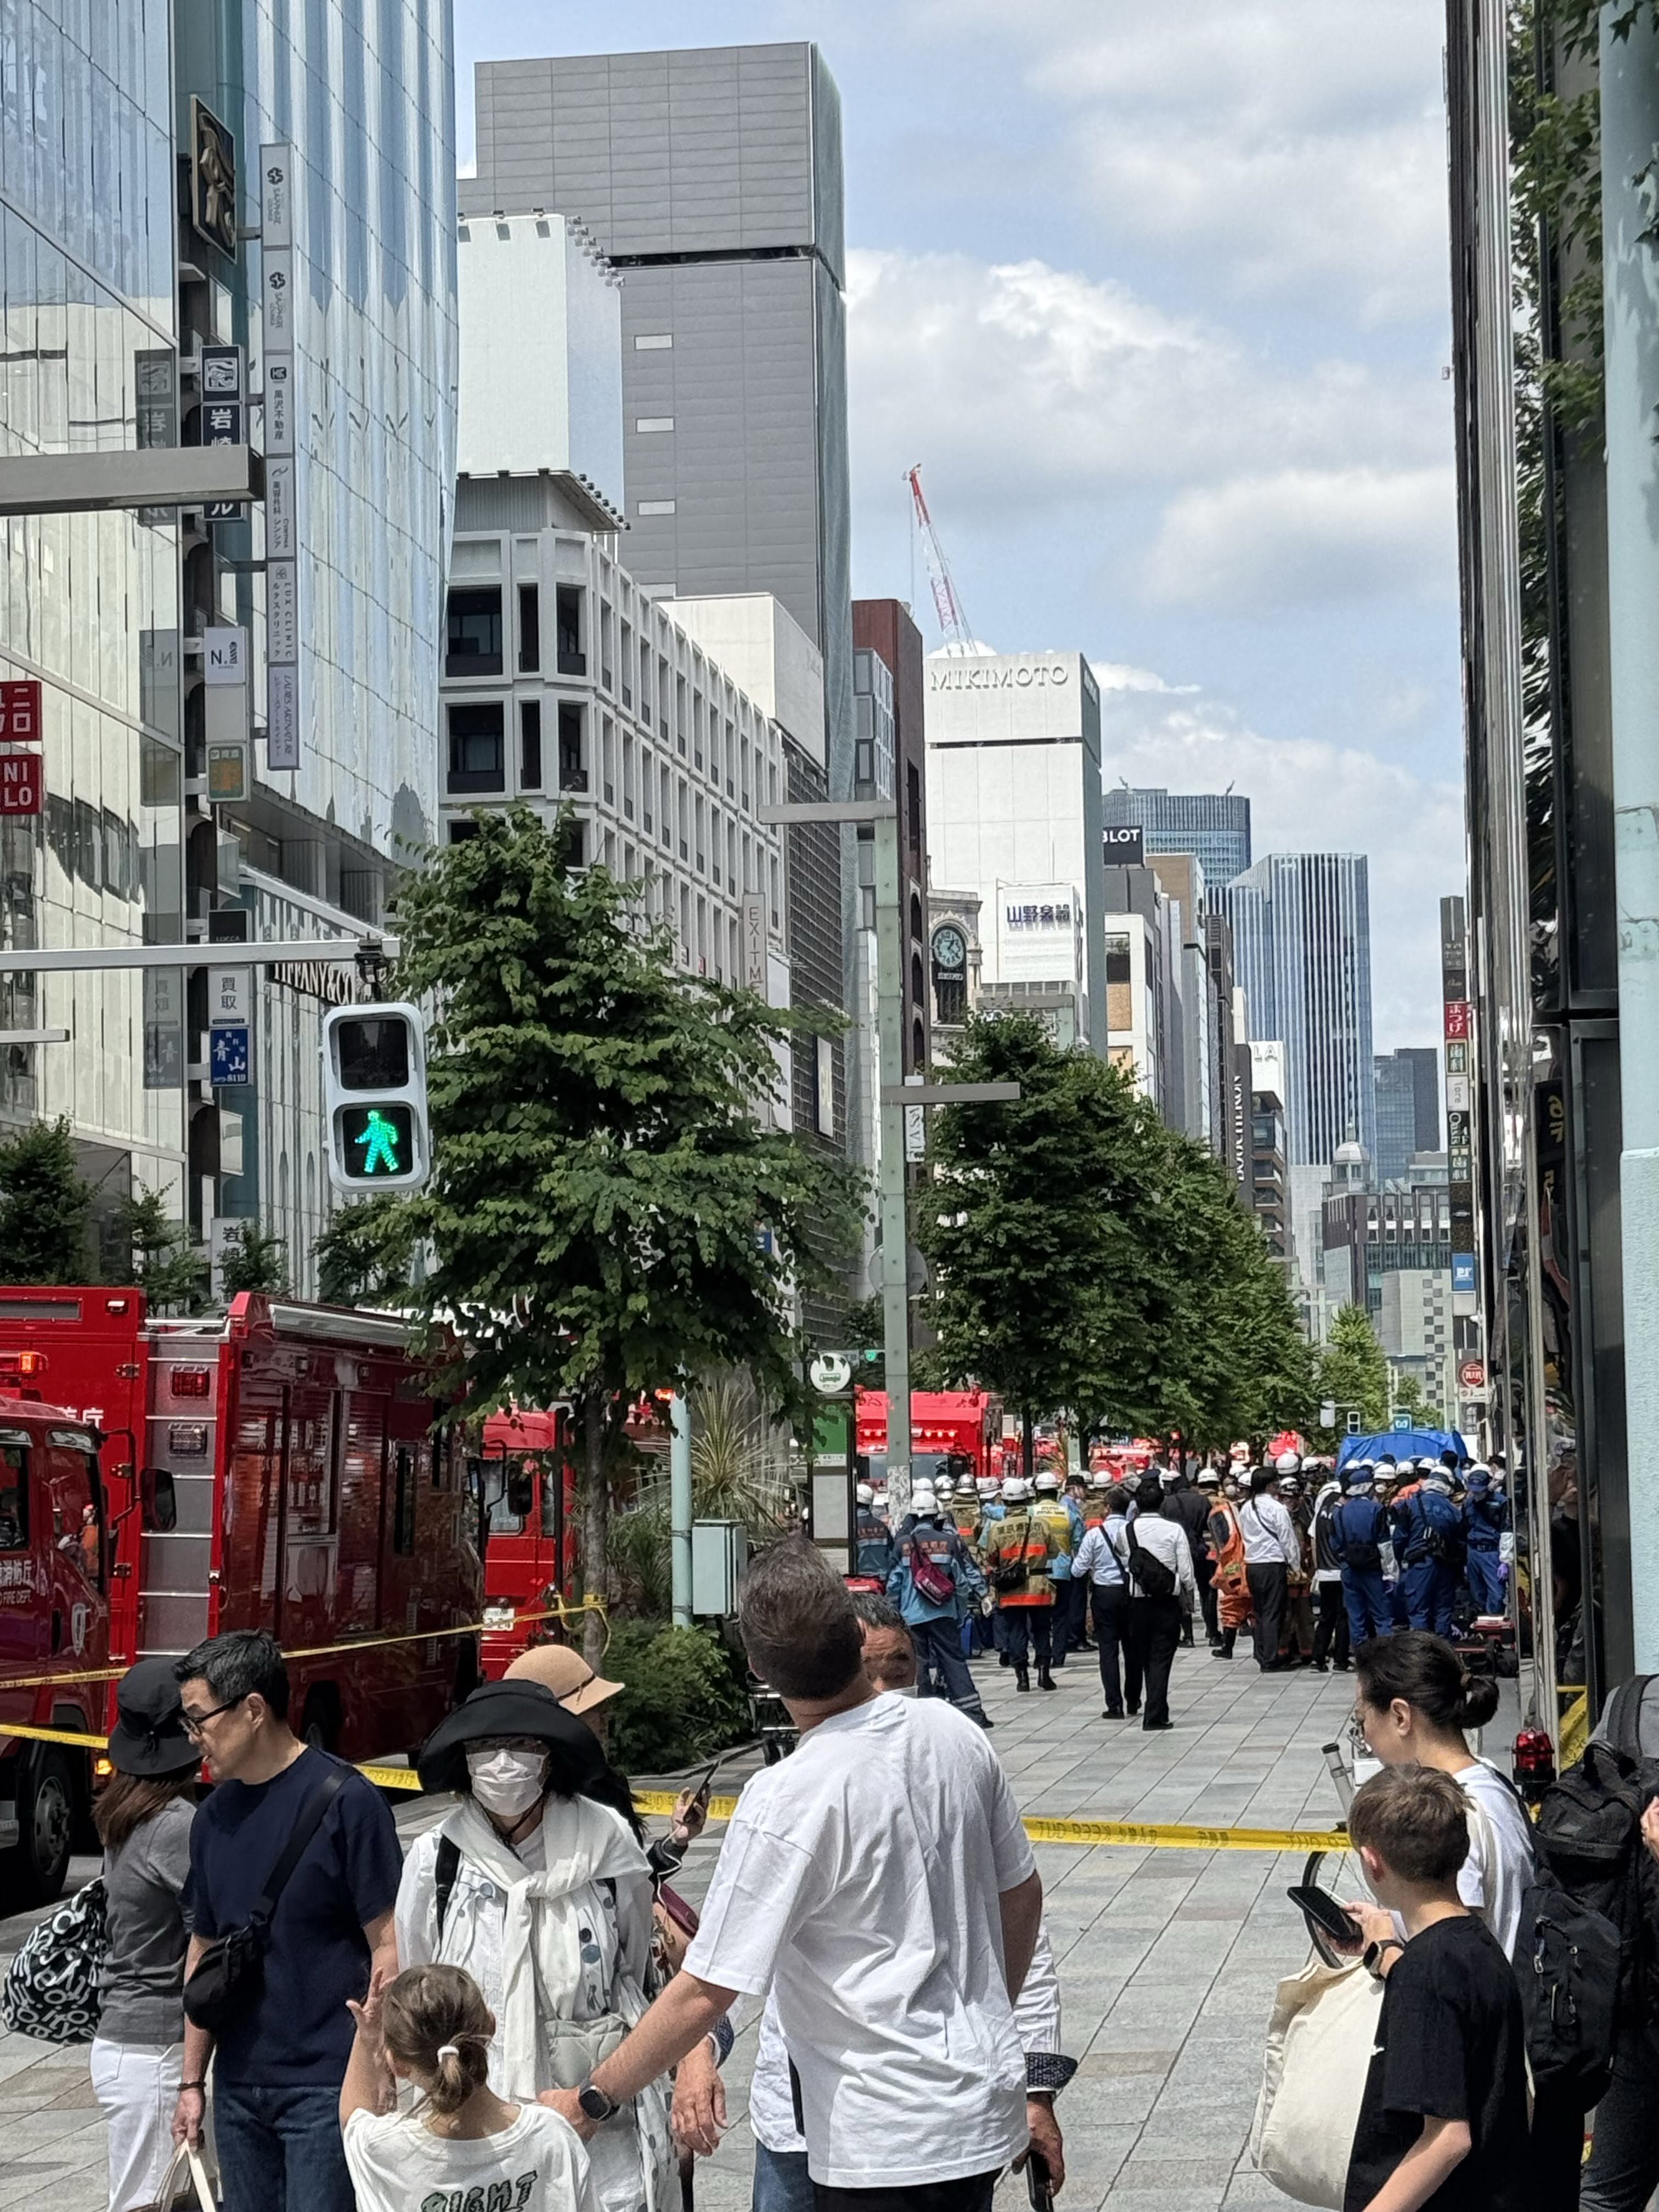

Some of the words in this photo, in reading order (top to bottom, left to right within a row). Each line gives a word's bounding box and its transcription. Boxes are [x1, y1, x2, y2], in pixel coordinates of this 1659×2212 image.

[284, 611, 292, 657] CLINIC
[931, 666, 1068, 691] MIKIMOTO
[1007, 904, 1070, 923] 山野楽器
[220, 977, 238, 1010] 買取
[1448, 1004, 1463, 1032] まつげ
